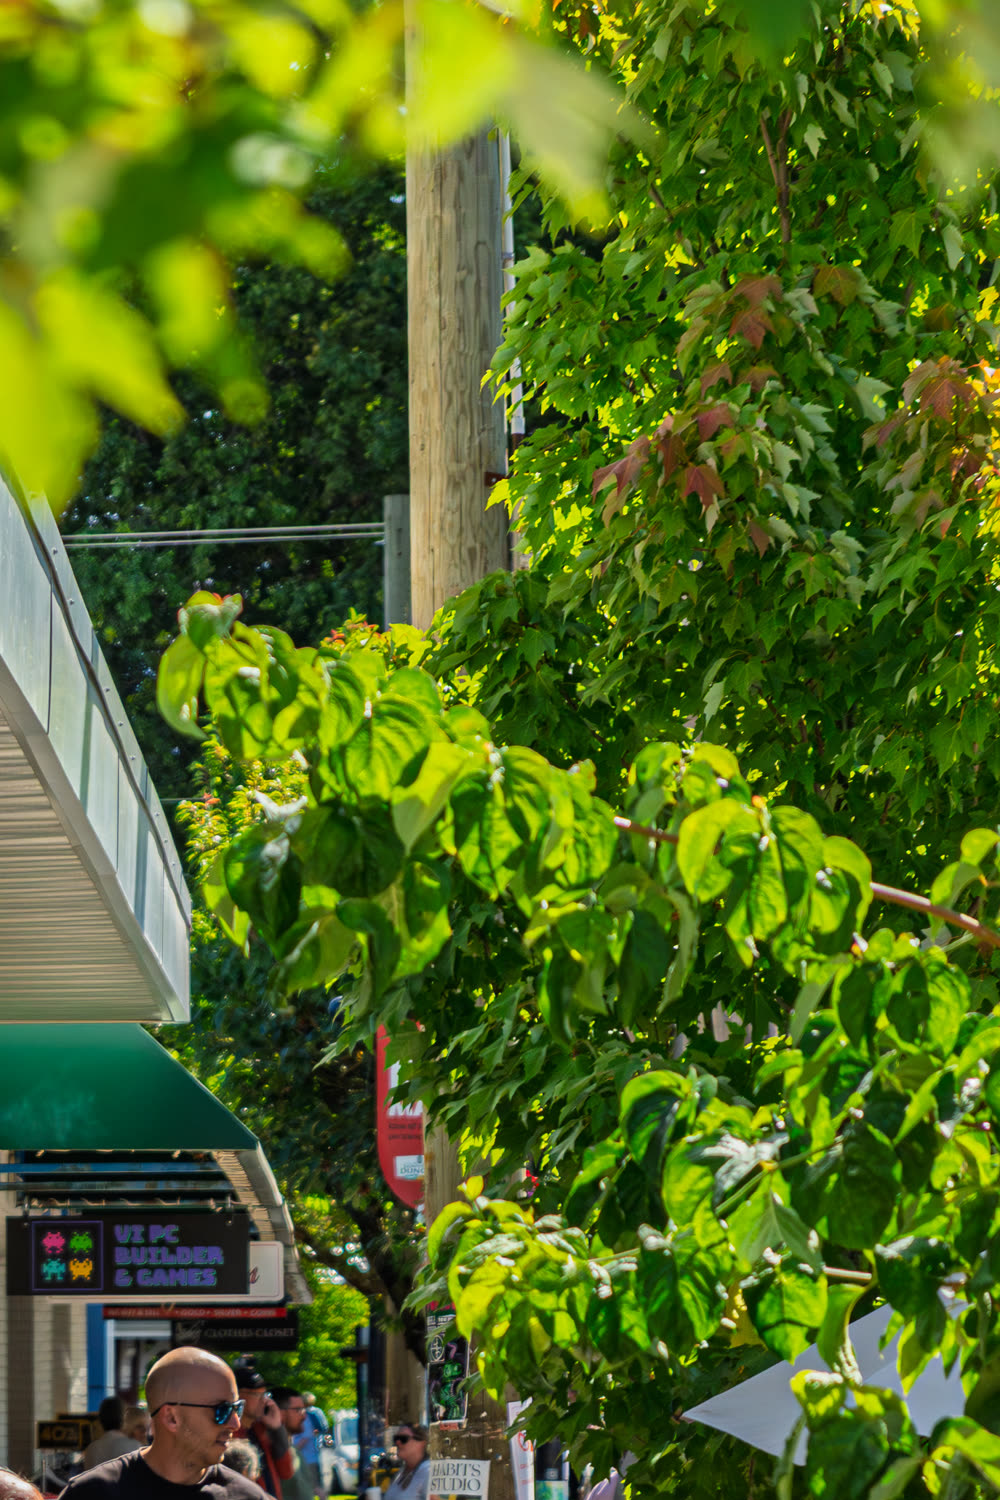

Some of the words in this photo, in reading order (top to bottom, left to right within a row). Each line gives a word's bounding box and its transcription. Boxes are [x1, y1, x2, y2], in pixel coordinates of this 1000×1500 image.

[113, 1224, 145, 1244] VI
[148, 1224, 180, 1244] PC
[114, 1246, 225, 1265] BUILDER
[114, 1268, 133, 1287] &
[136, 1268, 218, 1287] GAMES
[430, 1477, 481, 1491] STUDIO
